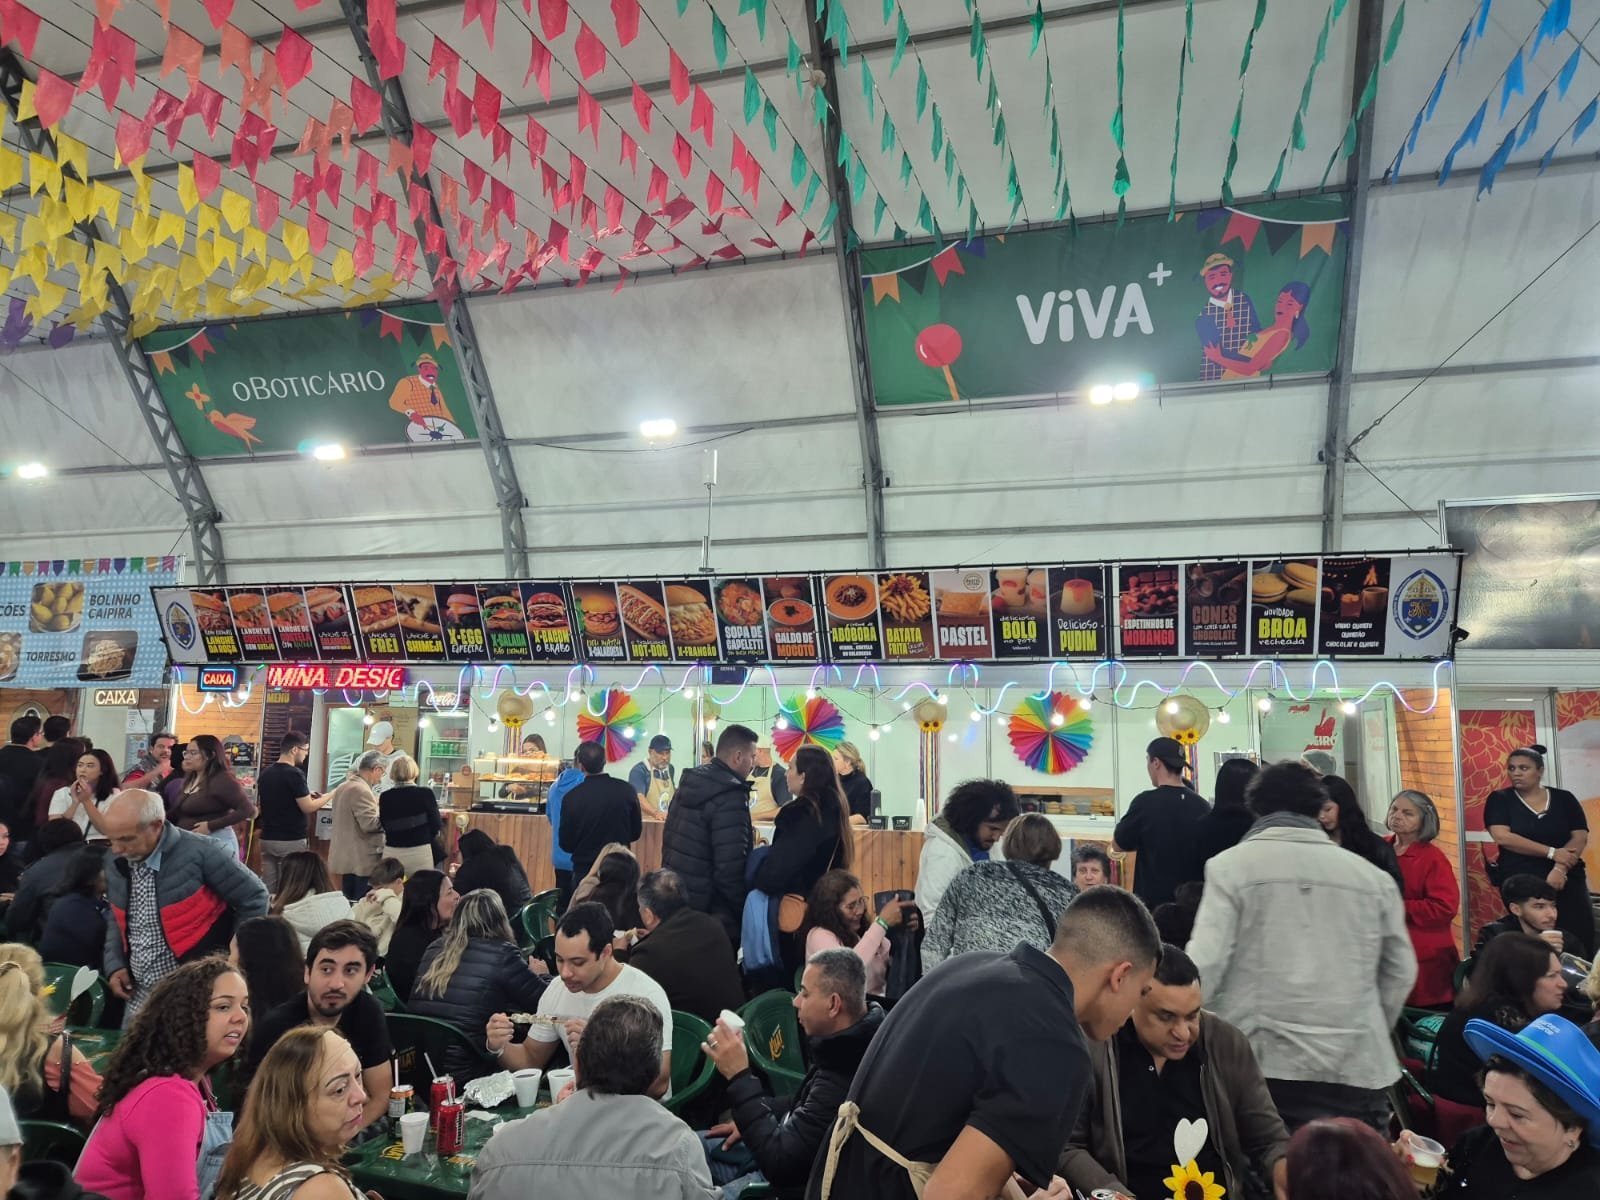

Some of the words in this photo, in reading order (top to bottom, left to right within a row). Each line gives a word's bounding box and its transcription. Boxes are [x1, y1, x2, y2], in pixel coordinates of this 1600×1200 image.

[89, 594, 141, 606] BOLINHO
[88, 608, 133, 619] CAIPIRA
[1193, 605, 1237, 624] CONES
[724, 625, 750, 639] SOPA
[750, 625, 763, 638] DE
[886, 627, 923, 643] BATATA
[1002, 621, 1037, 639] BOLO
[1258, 617, 1307, 639] BROA
[448, 628, 483, 645] X-EGG
[533, 629, 571, 643] X-BACON
[775, 632, 802, 644] CALDO
[802, 632, 814, 644] DE
[940, 625, 988, 647] PASTEL
[1060, 630, 1097, 652] PUDIM
[1123, 629, 1175, 646] MORANGO
[631, 644, 668, 657] HOT-DOG
[726, 638, 764, 650] CAPELETTI
[888, 642, 909, 656] FRITA
[26, 651, 76, 662] TORRESMO
[203, 672, 233, 685] CAIXA
[95, 690, 137, 705] CAIXA
